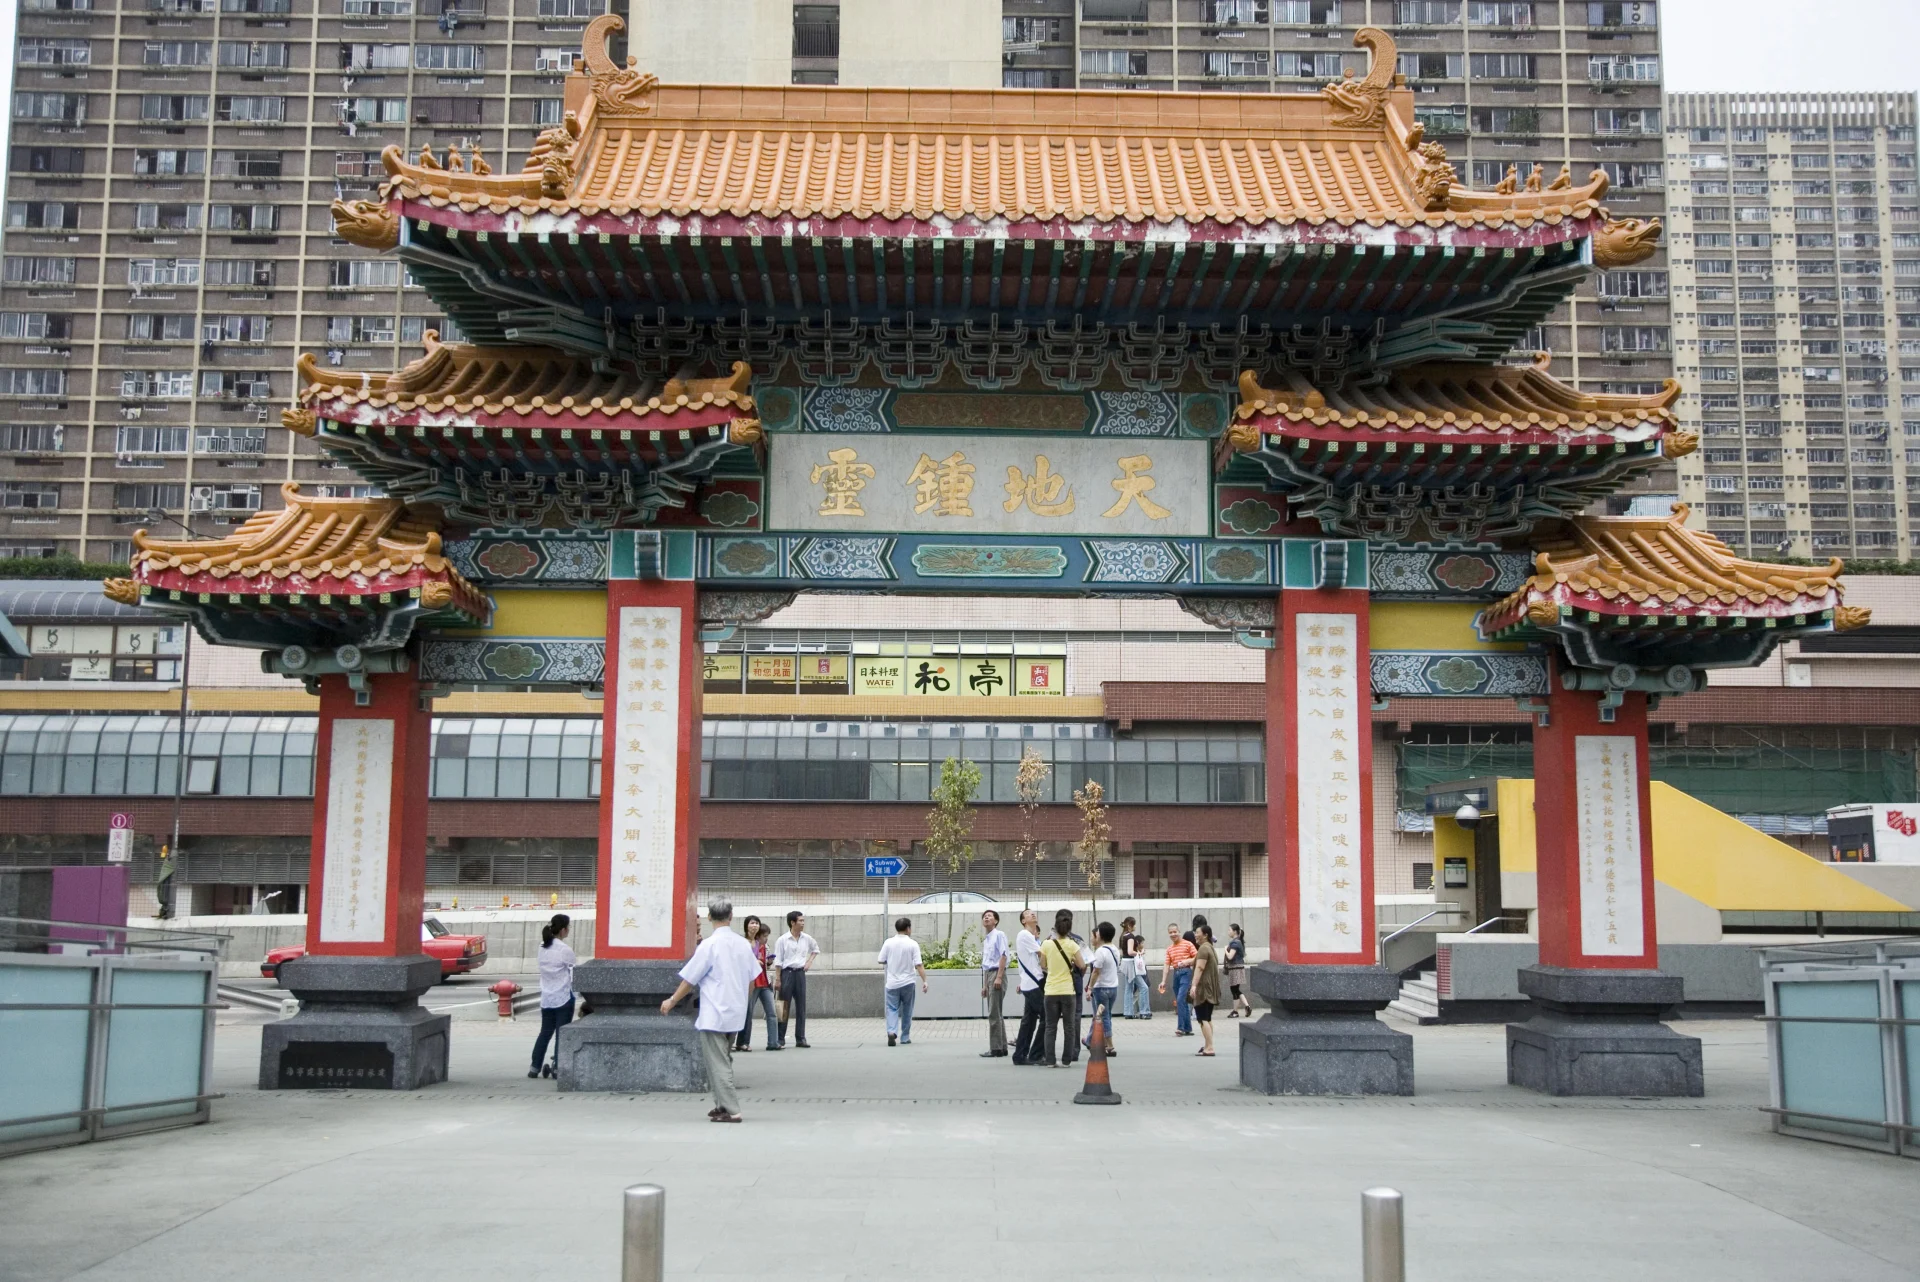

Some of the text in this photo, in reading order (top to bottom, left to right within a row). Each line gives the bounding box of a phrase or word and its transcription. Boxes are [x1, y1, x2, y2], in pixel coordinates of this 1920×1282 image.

[753, 658, 791, 668] 十一月初
[753, 668, 791, 677] 和您見面
[860, 666, 899, 677] 日本料理
